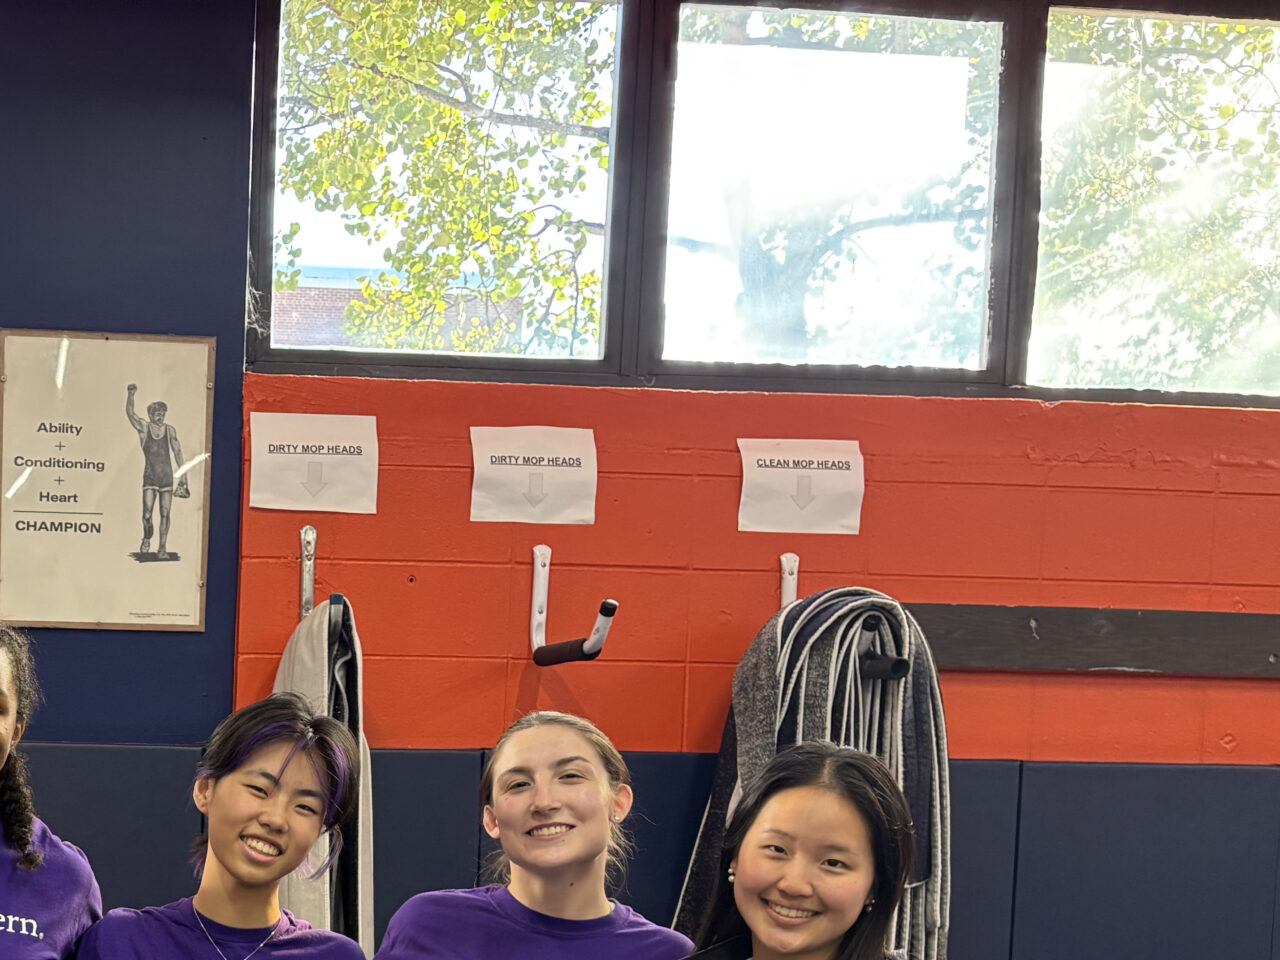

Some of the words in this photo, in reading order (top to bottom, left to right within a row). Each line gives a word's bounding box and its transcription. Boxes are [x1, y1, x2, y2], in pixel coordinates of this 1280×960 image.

[36, 421, 83, 436] Ability
[268, 443, 299, 454] DIRTY
[301, 444, 325, 454] MOP
[327, 445, 363, 455] HEADS
[13, 455, 105, 472] Conditioning
[490, 455, 520, 464] DIRTY
[522, 456, 545, 465] MOP
[547, 457, 582, 467] HEADS
[756, 458, 790, 468] CLEAN
[792, 459, 815, 469] MOP
[817, 460, 851, 470] HEADS
[38, 491, 79, 503] Heart
[15, 519, 102, 534] CHAMPION
